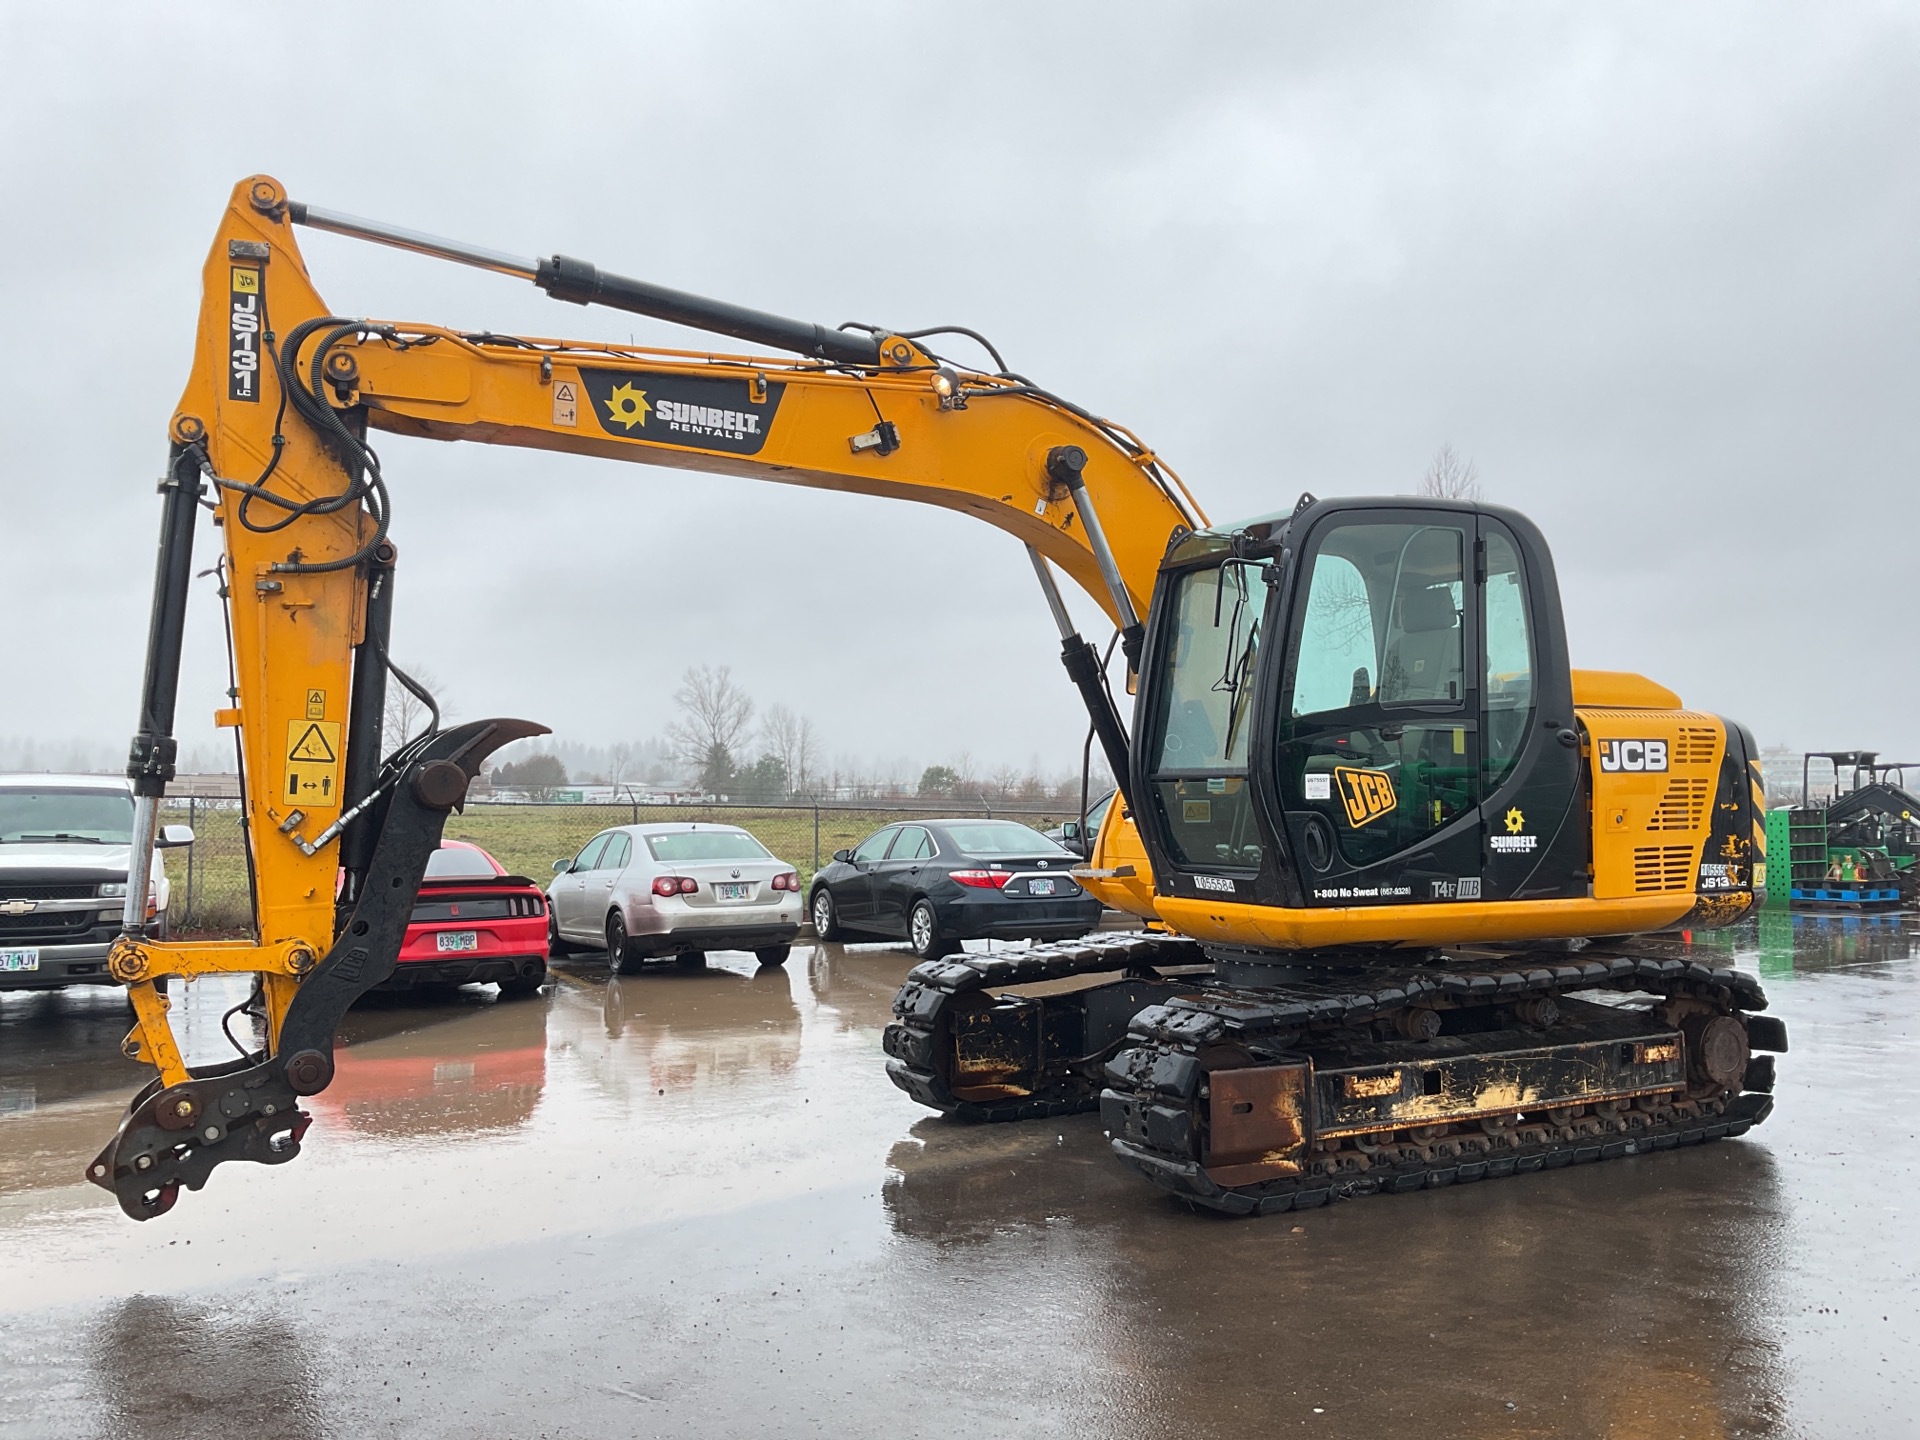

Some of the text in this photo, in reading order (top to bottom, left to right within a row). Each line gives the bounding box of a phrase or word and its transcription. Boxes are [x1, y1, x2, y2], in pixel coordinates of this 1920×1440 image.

[232, 295, 258, 396] JS131 LC
[656, 400, 759, 434] SUNBELT
[670, 421, 744, 440] RENTALS
[1601, 741, 1668, 771] JCB
[1346, 772, 1392, 820] JCB
[1490, 835, 1537, 848] SUNBELT
[1193, 876, 1234, 891] 1055584
[720, 886, 733, 898] 769
[1313, 889, 1338, 898] 1-800
[1340, 887, 1352, 897] No
[1353, 886, 1379, 898] Sweat
[439, 935, 476, 947] 839 MBP
[18, 954, 37, 966] NJV
